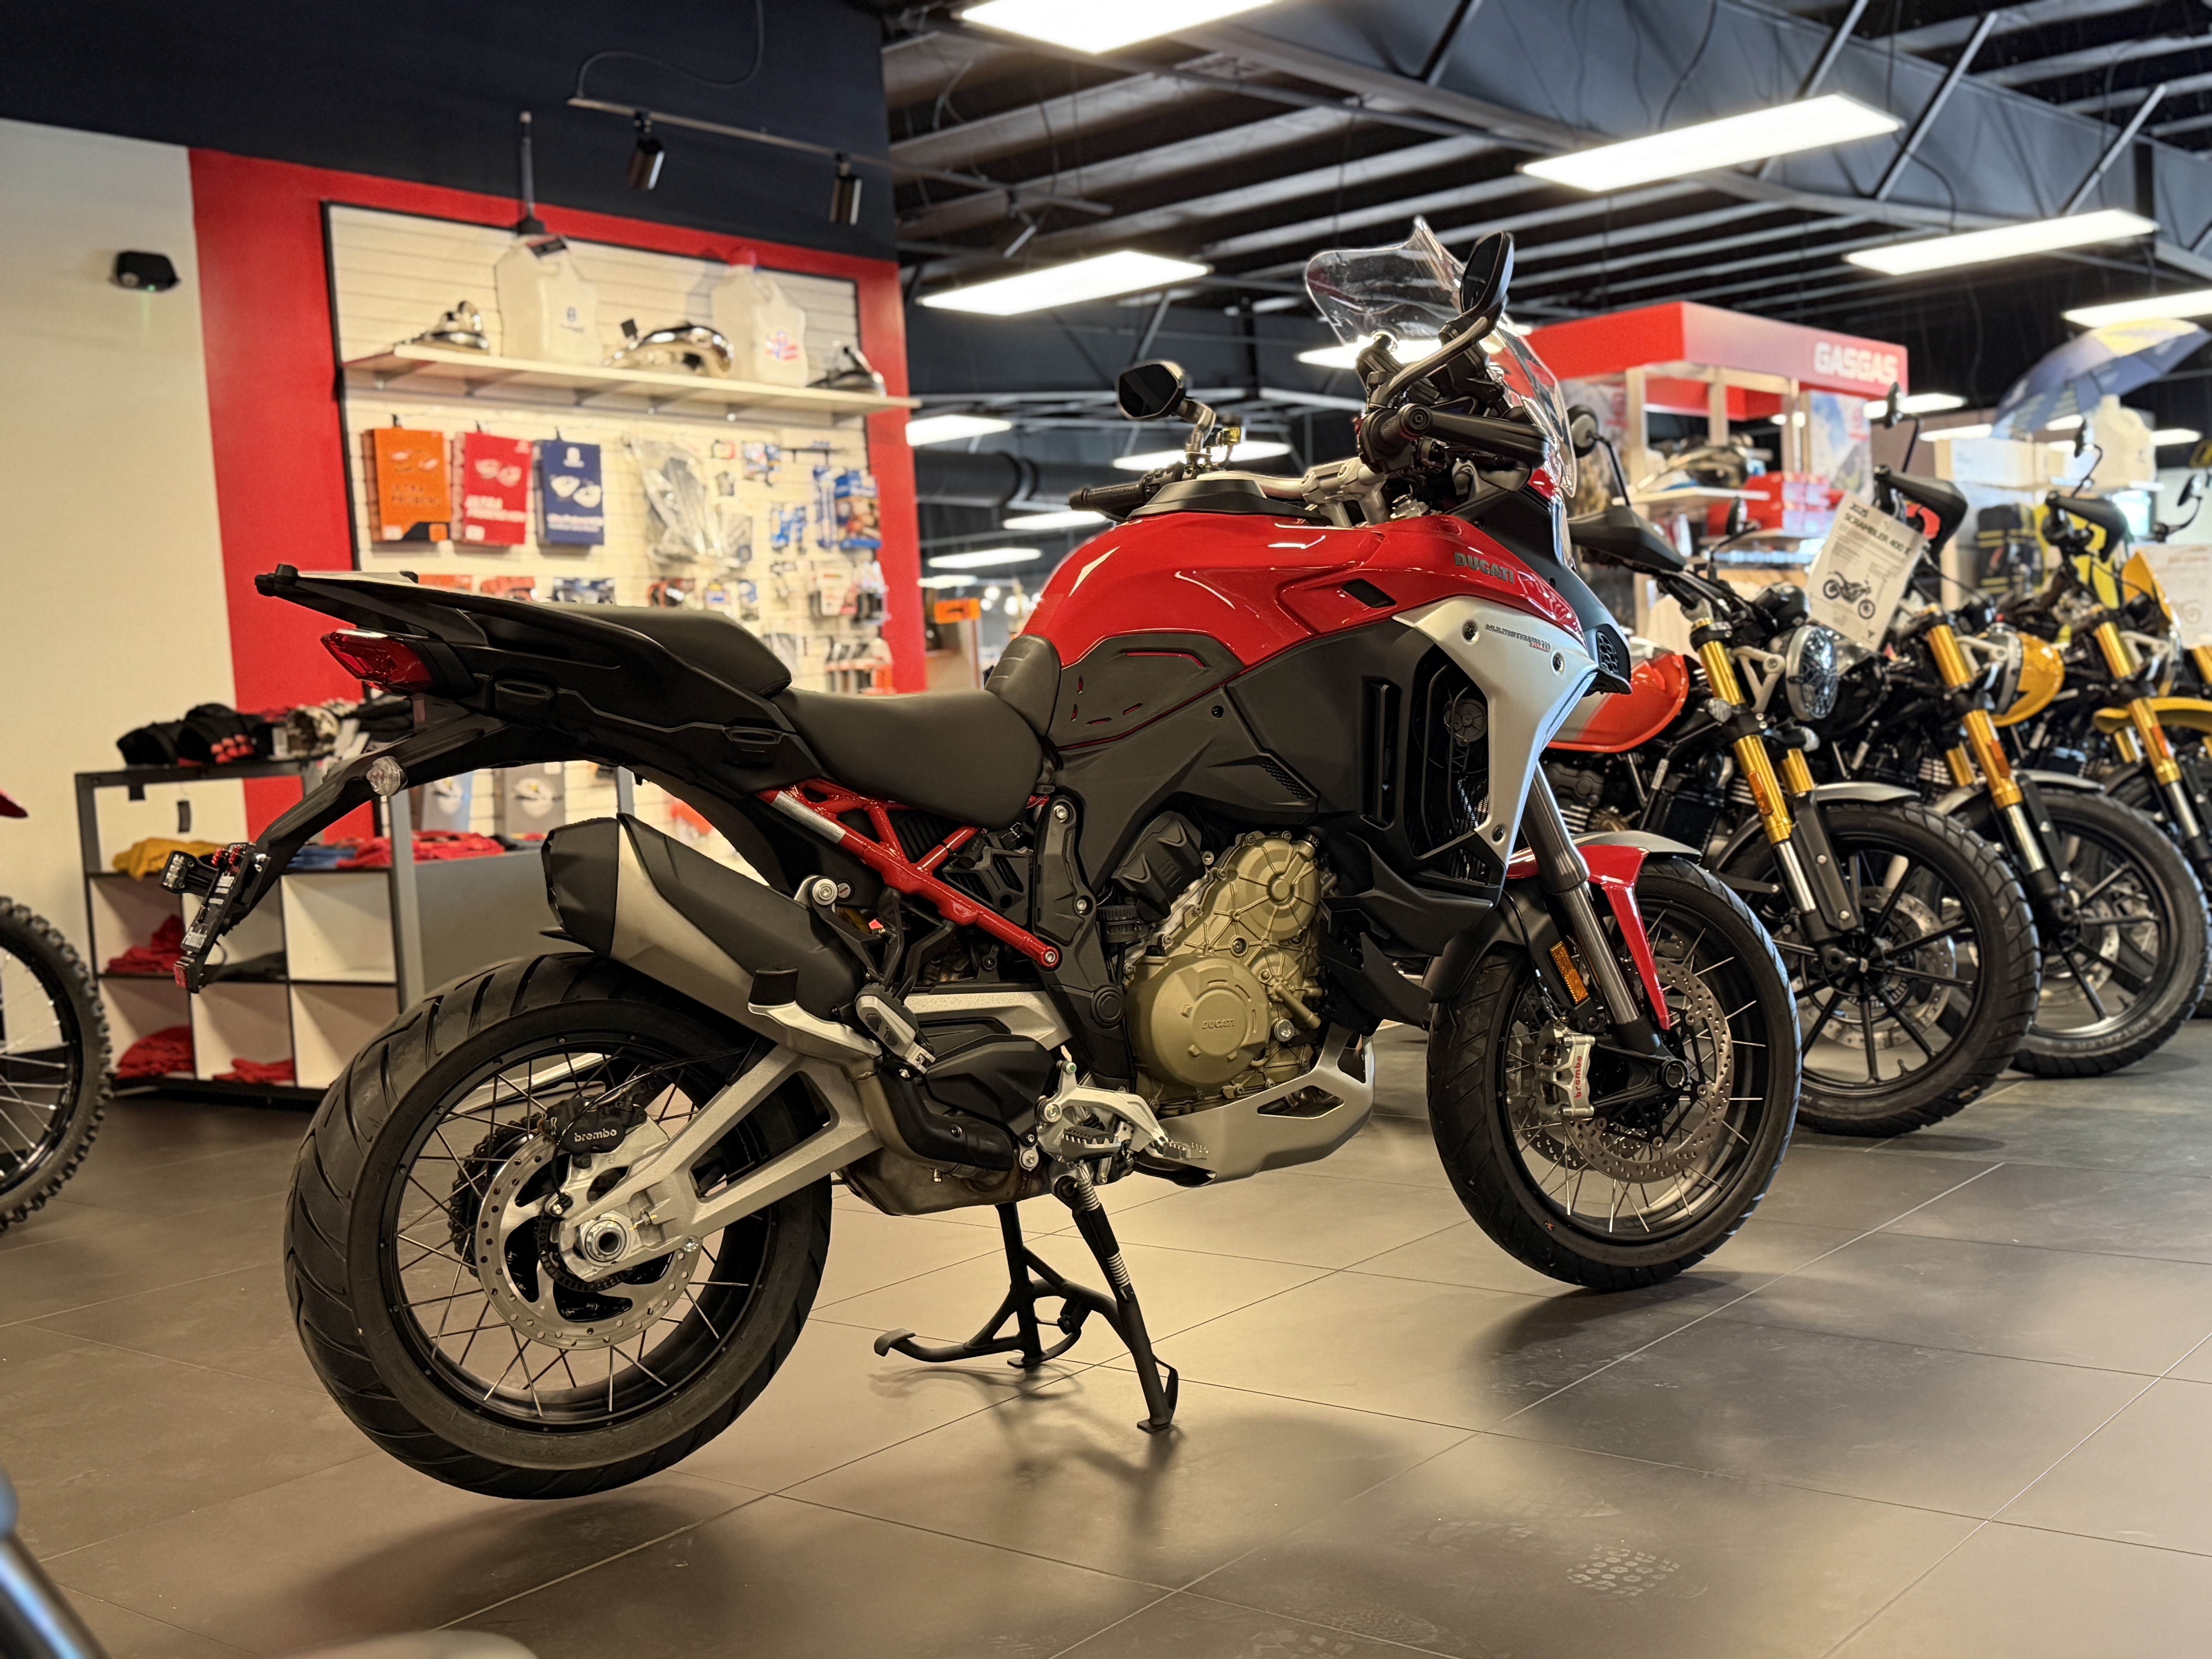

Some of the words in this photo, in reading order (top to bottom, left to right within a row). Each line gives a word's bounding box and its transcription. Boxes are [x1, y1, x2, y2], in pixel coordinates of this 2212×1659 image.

[1814, 342, 1898, 385] GASGAS
[1843, 513, 1889, 543] SCRAMBLER
[1454, 552, 1514, 584] DUCATI
[1202, 1019, 1235, 1029] DUCATI
[1574, 1055, 1582, 1099] brembo
[574, 1128, 617, 1142] brembo
